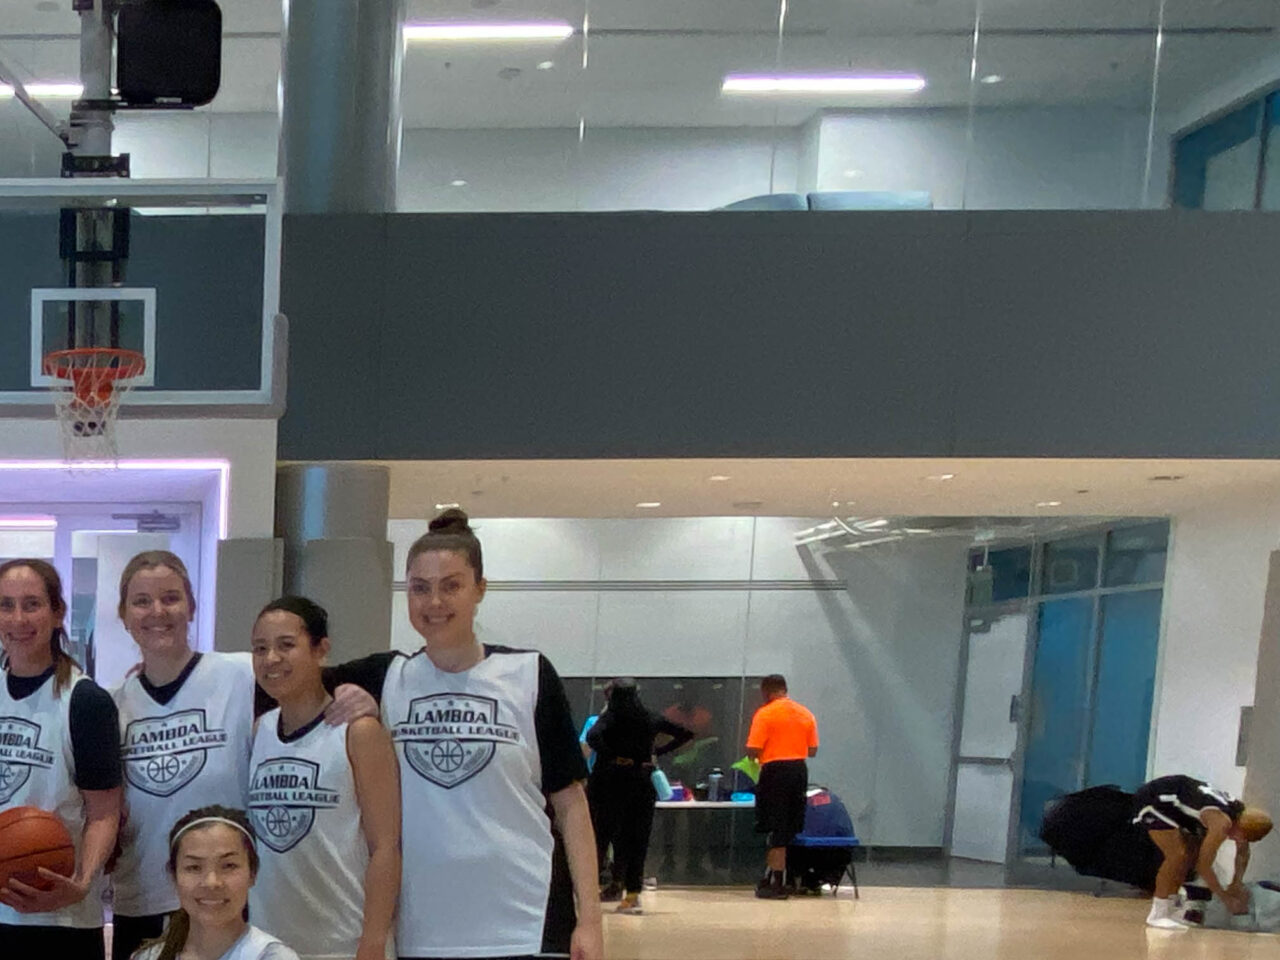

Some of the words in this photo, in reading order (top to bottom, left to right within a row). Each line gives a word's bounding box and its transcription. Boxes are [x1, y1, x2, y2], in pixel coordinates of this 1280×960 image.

[415, 708, 488, 724] LAMBDA
[130, 723, 200, 746] LAMBDA
[254, 774, 310, 789] LAMBDA
